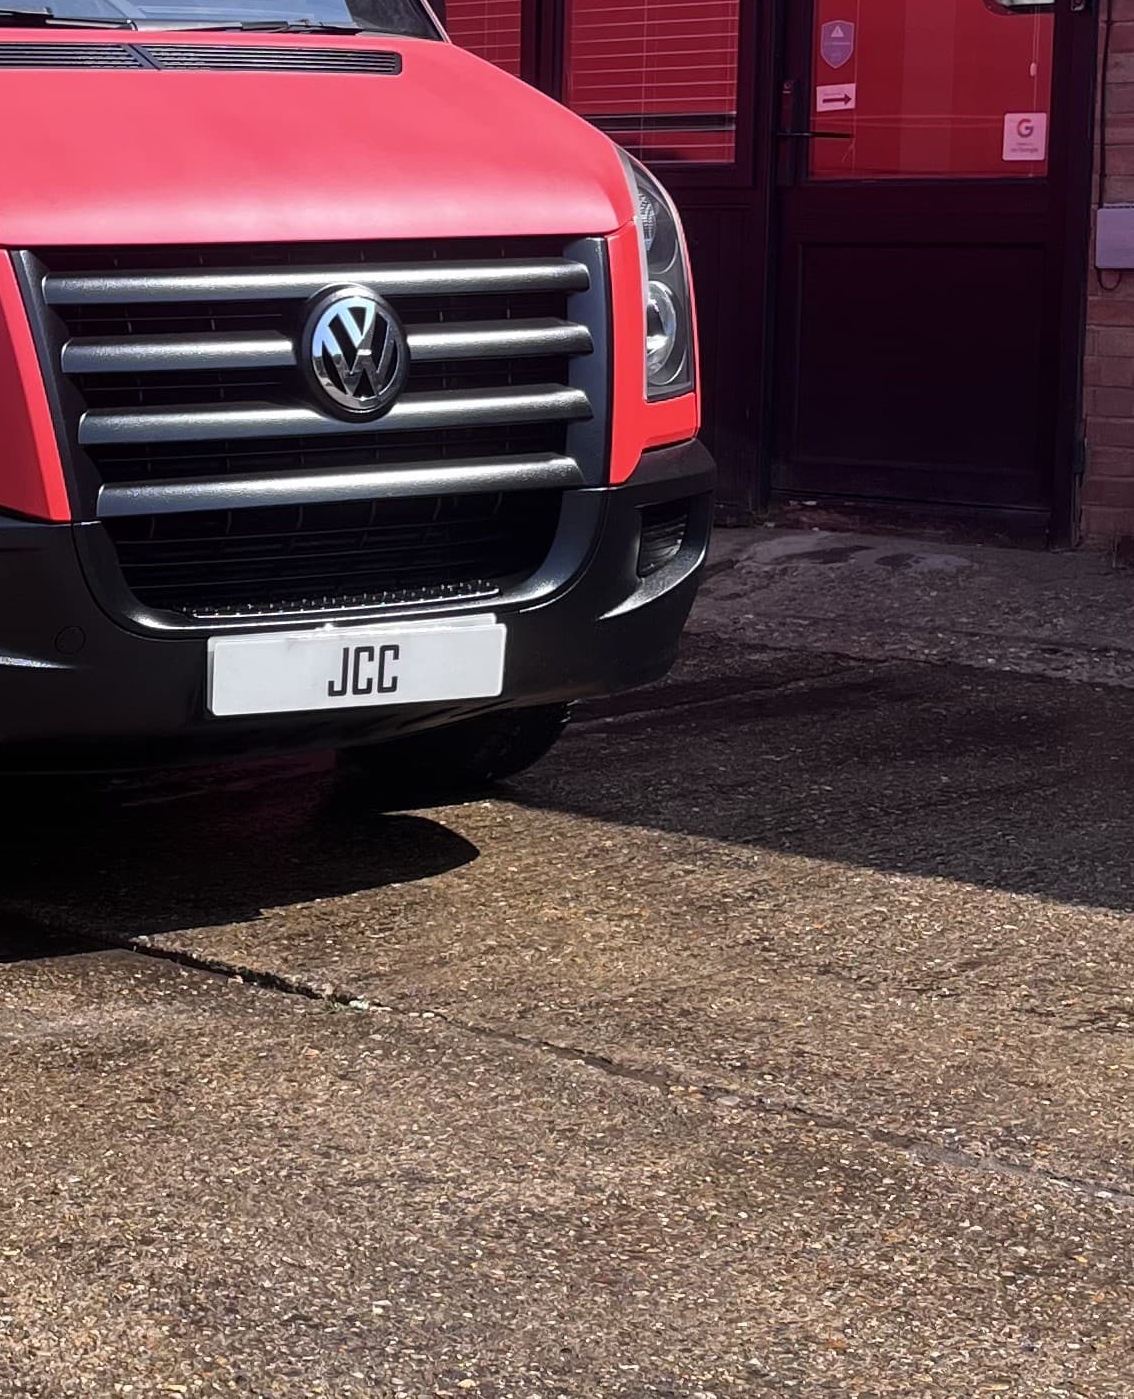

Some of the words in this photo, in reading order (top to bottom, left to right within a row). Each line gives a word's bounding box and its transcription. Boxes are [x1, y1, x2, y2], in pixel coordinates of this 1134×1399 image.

[1017, 118, 1034, 138] G
[312, 296, 400, 413] VW
[328, 644, 400, 697] JCC
